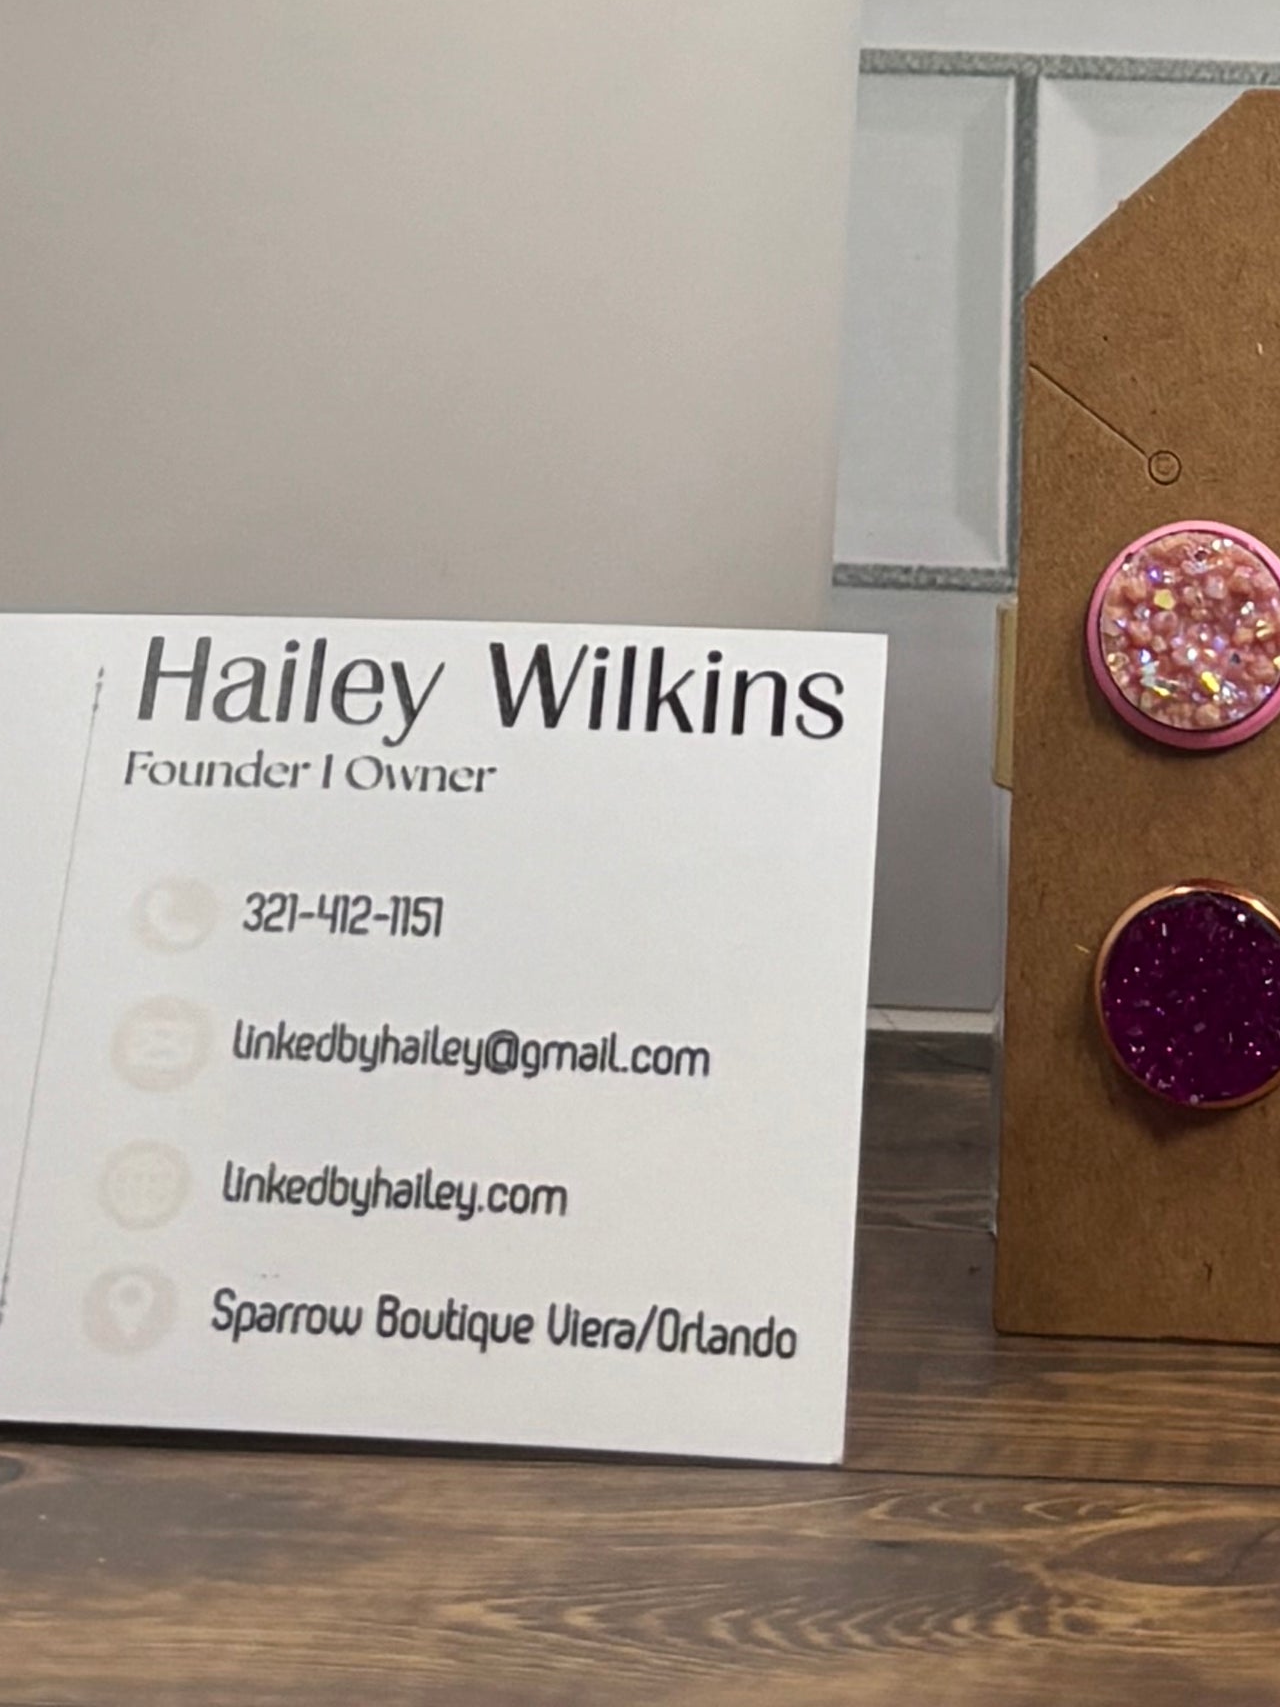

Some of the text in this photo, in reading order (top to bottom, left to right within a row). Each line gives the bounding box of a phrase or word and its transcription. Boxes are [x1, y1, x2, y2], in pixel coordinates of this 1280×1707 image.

[136, 635, 846, 749] Hailey Wilkins
[123, 748, 312, 790] Founder
[344, 753, 498, 794] Owner
[241, 890, 445, 939] 321-412-1151
[231, 1018, 711, 1080] linkedbyhailey@gmail.com
[221, 1159, 569, 1223] linkedbyhailey.com
[210, 1286, 798, 1361] Sparrow Boutique Viera/Orlando
